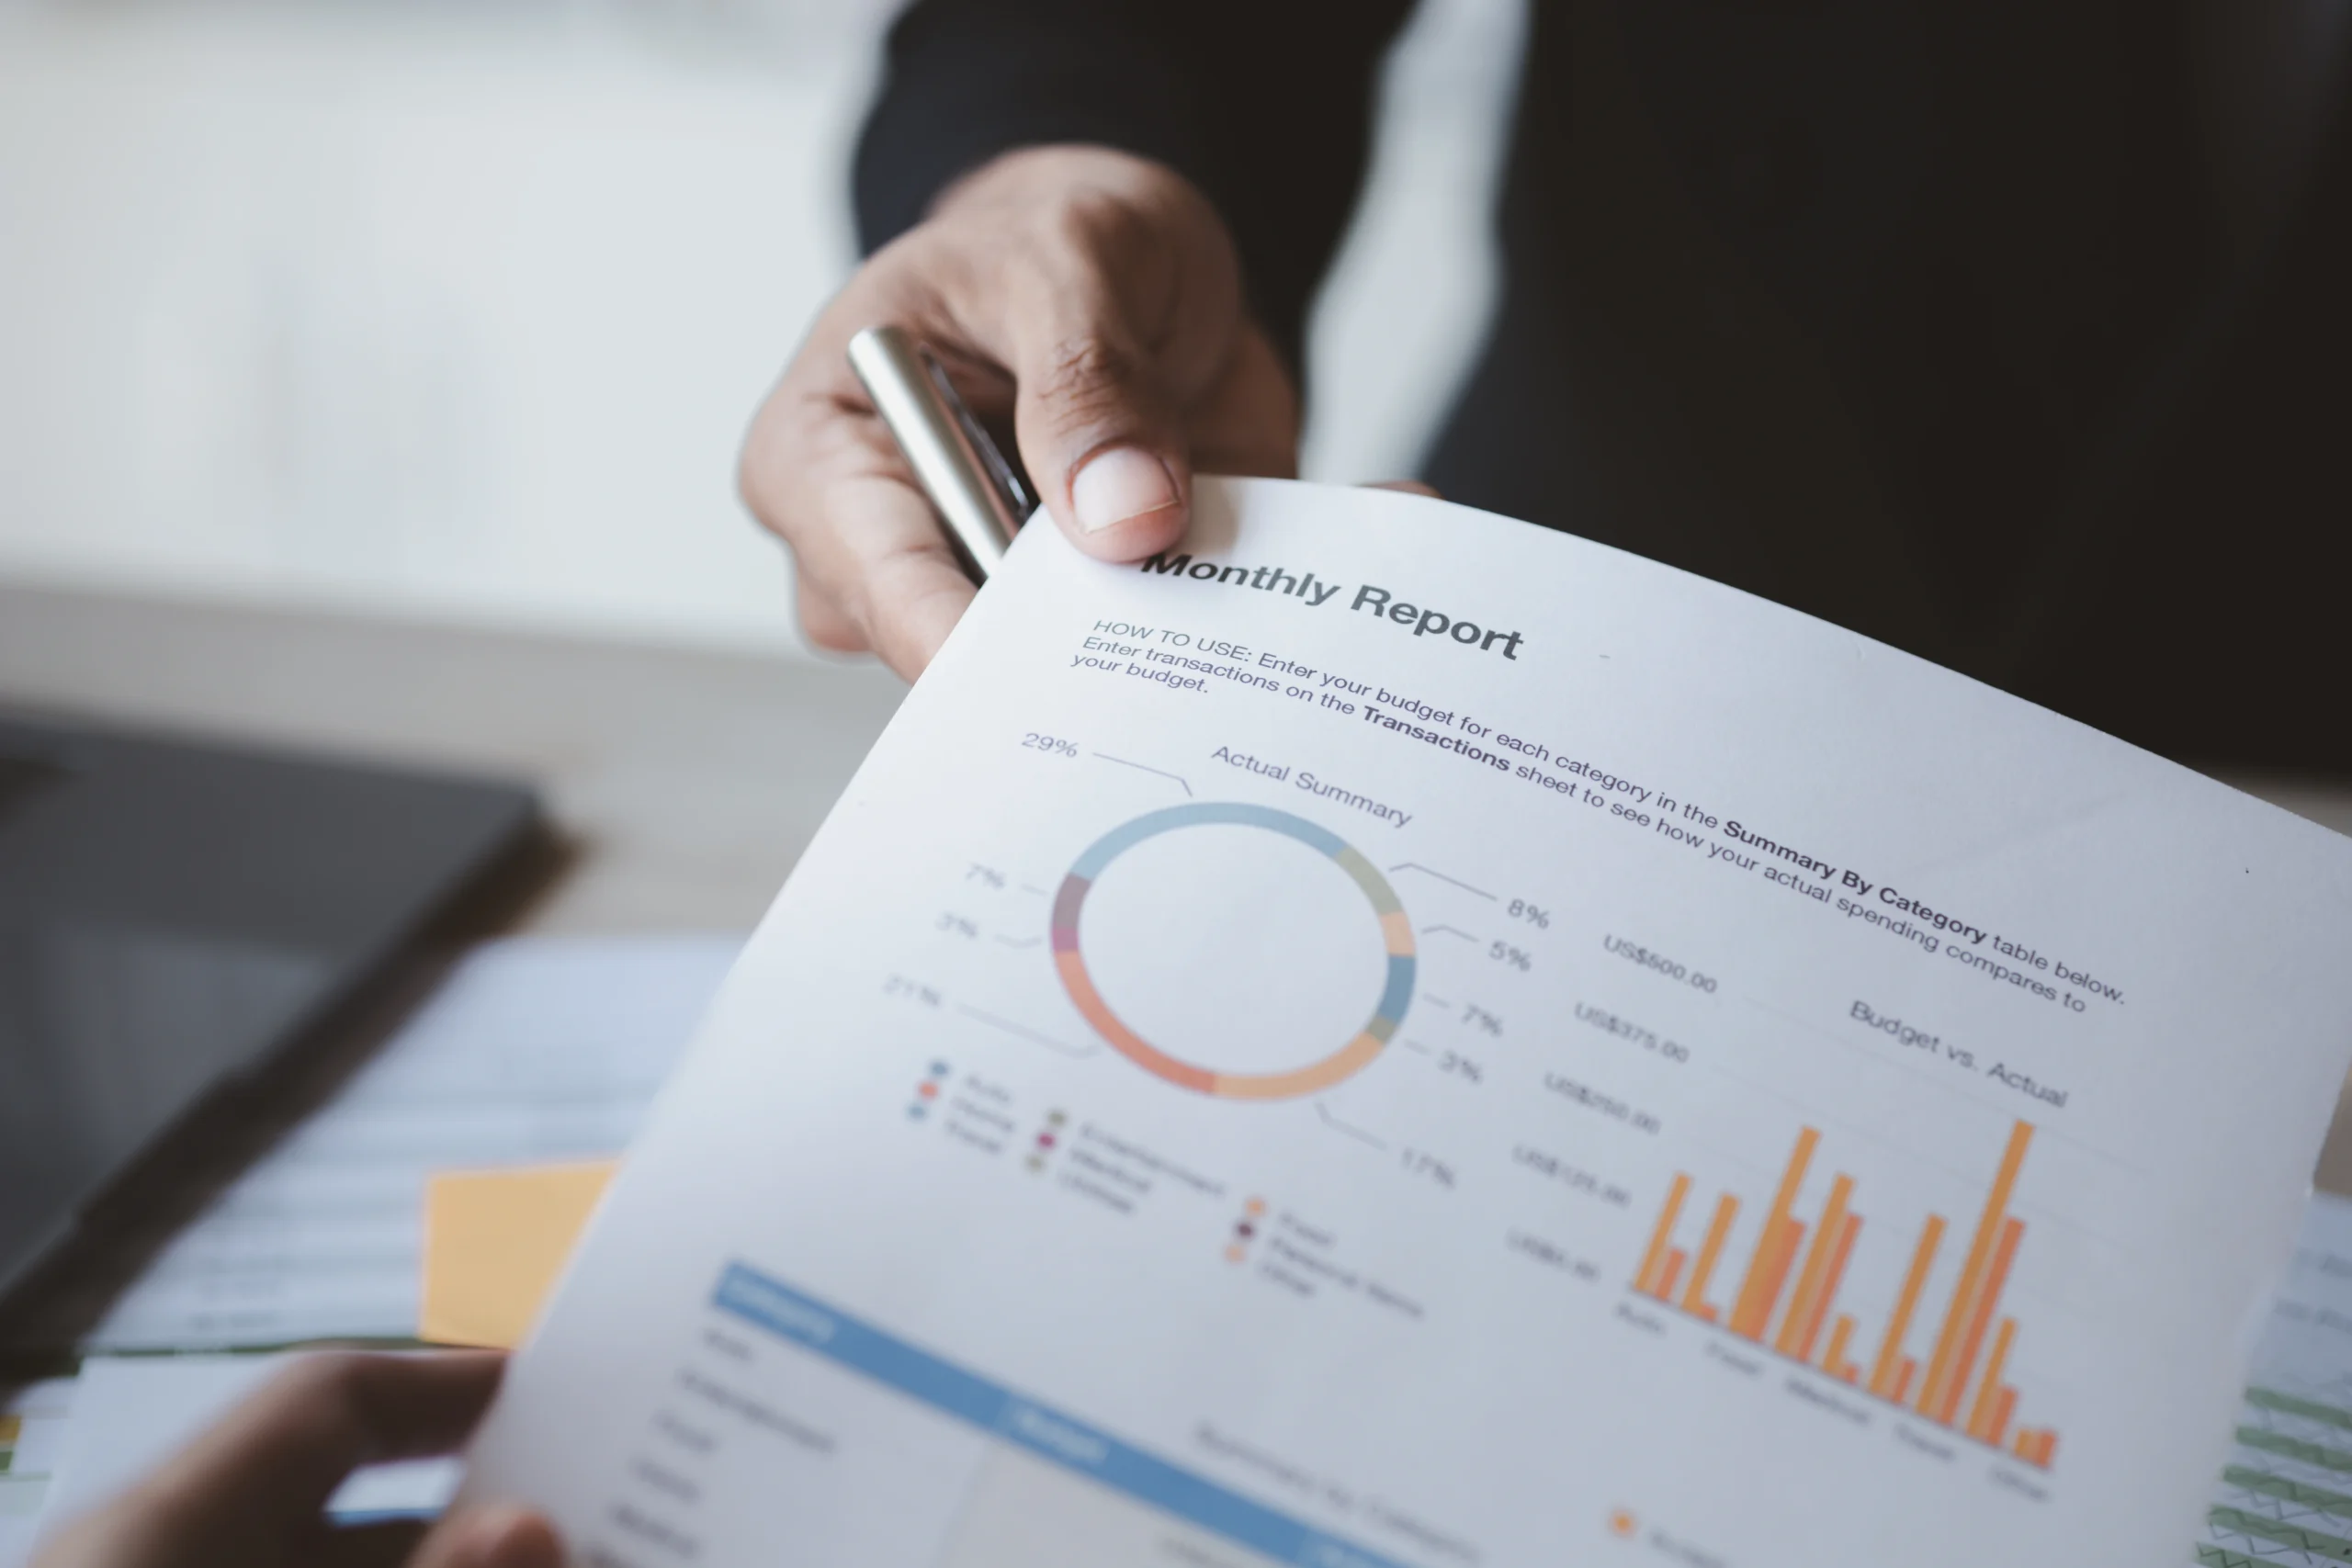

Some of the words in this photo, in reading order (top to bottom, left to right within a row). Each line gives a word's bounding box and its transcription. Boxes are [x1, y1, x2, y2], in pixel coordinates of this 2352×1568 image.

[1141, 553, 1341, 607] Monthly
[1351, 584, 1524, 661] Report
[1070, 654, 1123, 672] your
[1125, 661, 1208, 694] budget.
[1021, 732, 1080, 758] 29%
[1093, 619, 1154, 639] HOW
[1160, 629, 1191, 647] TO
[1196, 637, 1252, 662] USE:
[1258, 651, 1317, 680] Enter
[1319, 672, 1373, 697] your
[1375, 687, 1455, 726] budget
[1459, 716, 1492, 739] for
[1496, 734, 1550, 761] each
[1555, 755, 1653, 804] category
[1656, 791, 1677, 813] in
[1683, 803, 1718, 829] the
[1724, 820, 1838, 880] Summary
[1841, 869, 1874, 896] By
[1879, 886, 1988, 945] Category
[1992, 934, 2049, 970] table
[2054, 961, 2125, 1006] below.
[1211, 745, 1291, 782] Actual
[1295, 772, 1413, 829] Summary
[1082, 636, 1142, 659] Enter
[1147, 648, 1280, 692] transactions
[1285, 684, 1314, 703] on
[1319, 692, 1355, 715] the
[1363, 705, 1510, 773] Transactions
[1515, 764, 1578, 797] sheet
[1582, 788, 1605, 808] to
[1610, 802, 1651, 827] see
[1656, 818, 1705, 849] how
[1707, 842, 1761, 872] your
[1763, 866, 1833, 904] actual
[1836, 897, 1940, 953] spending
[1945, 944, 2058, 1001] compares
[2063, 991, 2086, 1013] to
[1507, 897, 1551, 931] 8%
[1488, 939, 1532, 972] 5%
[1601, 932, 1719, 995] US$500.00
[1461, 1001, 1504, 1039] 7%
[1849, 999, 1939, 1054] Budget
[1946, 1044, 1978, 1072] vs.
[1986, 1061, 2070, 1109] Actual
